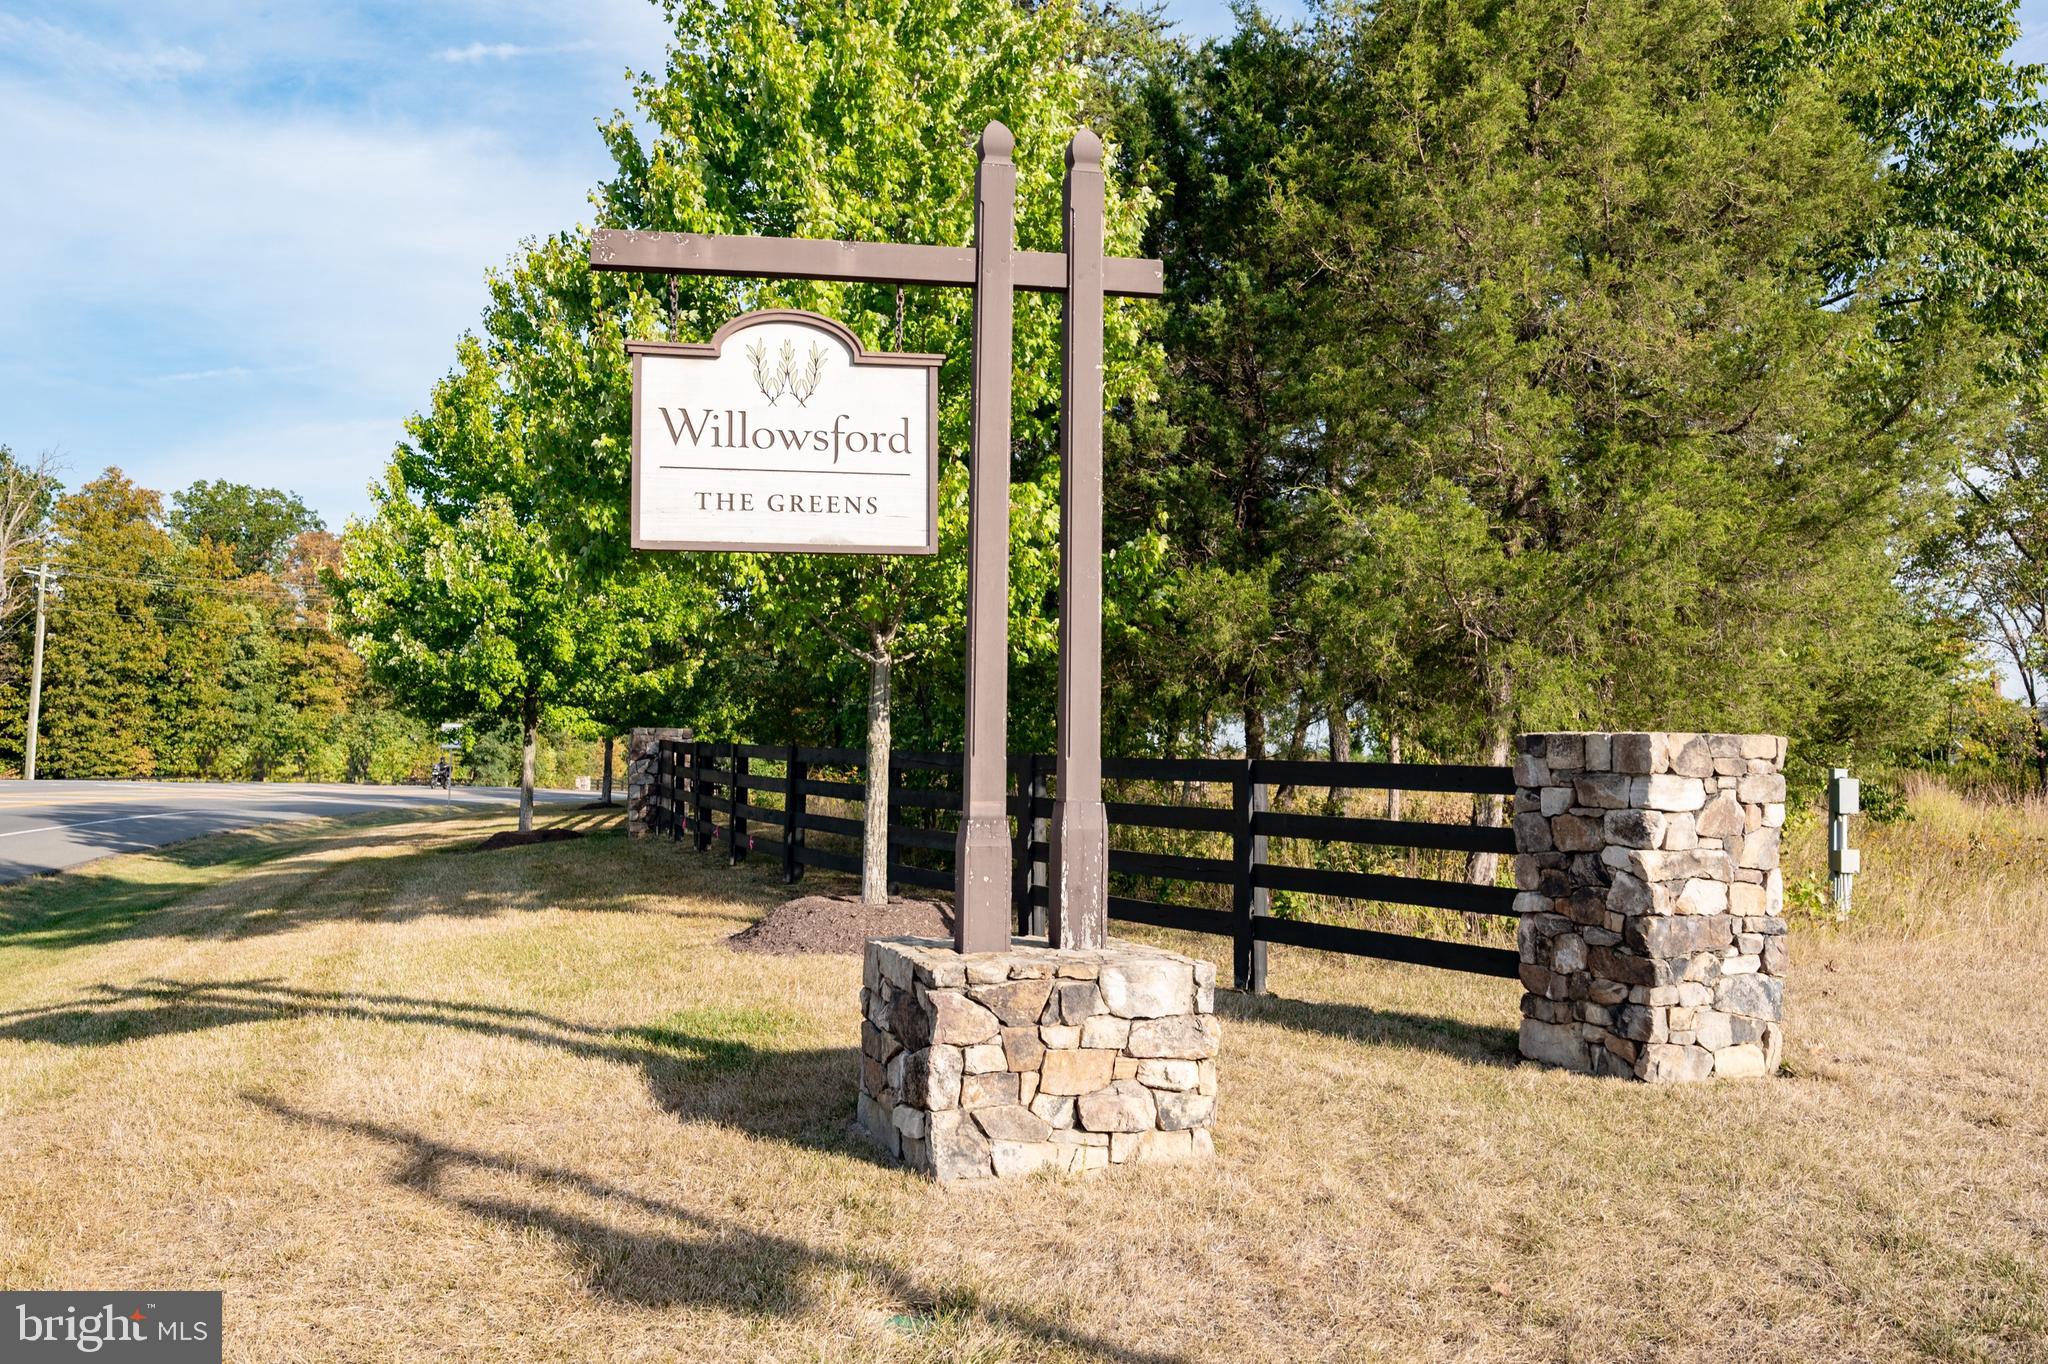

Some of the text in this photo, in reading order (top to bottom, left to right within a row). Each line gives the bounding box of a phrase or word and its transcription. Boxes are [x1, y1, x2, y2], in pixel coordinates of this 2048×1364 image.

[658, 407, 912, 464] Willowsford
[695, 491, 878, 514] THE GREENS
